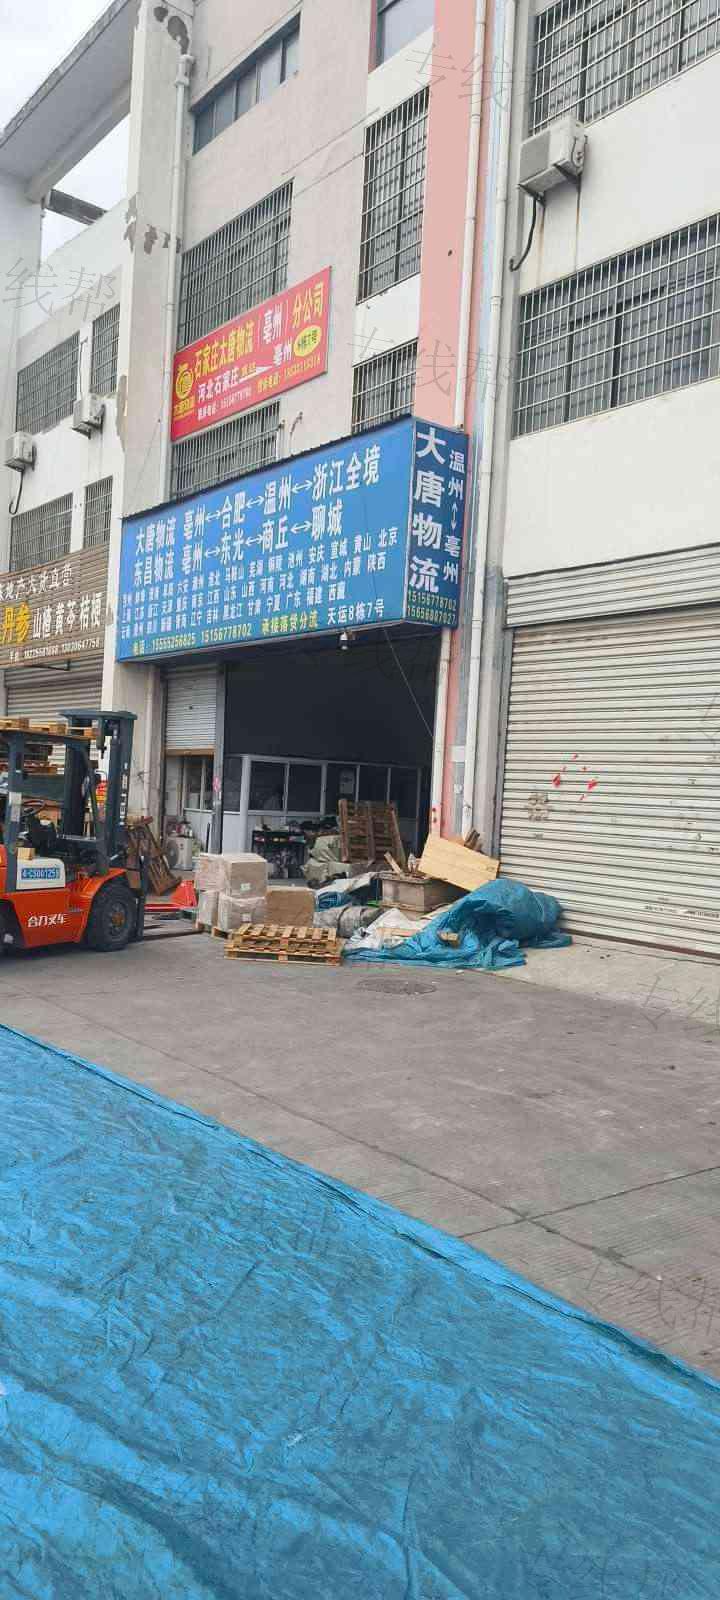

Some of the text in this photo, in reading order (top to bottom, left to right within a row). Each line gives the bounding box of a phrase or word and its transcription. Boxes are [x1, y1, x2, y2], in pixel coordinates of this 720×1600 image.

[135, 443, 380, 553] 大唐物流 亳州 合肥 温州 浙江全境
[409, 427, 446, 592] 大唐物流
[442, 450, 465, 585] 温州 亳州
[134, 498, 343, 585] 东昌物流 亳州 东光 商丘 聊城
[287, 550, 302, 570] 池州
[308, 545, 324, 566] 安庆
[329, 540, 347, 561] 宣城
[353, 534, 370, 556] 黄山
[377, 527, 398, 550] 北京
[191, 610, 201, 626] 辽宁
[206, 607, 218, 623] 吉林
[223, 603, 241, 620] 黑龙江
[247, 599, 260, 616] 甘肃
[266, 595, 280, 613] 宁夏
[285, 591, 300, 610] 广东
[306, 587, 322, 606] 福建
[328, 583, 344, 602] 西藏
[207, 588, 219, 605] 江西
[223, 585, 236, 602] 山东
[241, 581, 254, 598] 山西
[260, 577, 274, 595] 河南
[279, 572, 293, 591] 河北
[300, 568, 314, 587] 湖南
[321, 563, 337, 583] 湖北
[344, 558, 360, 578] 内蒙
[367, 553, 385, 574] 陕西
[201, 622, 251, 643] 15156778702
[327, 600, 385, 624] 天运8栋7号
[27, 912, 66, 928] 合力叉车
